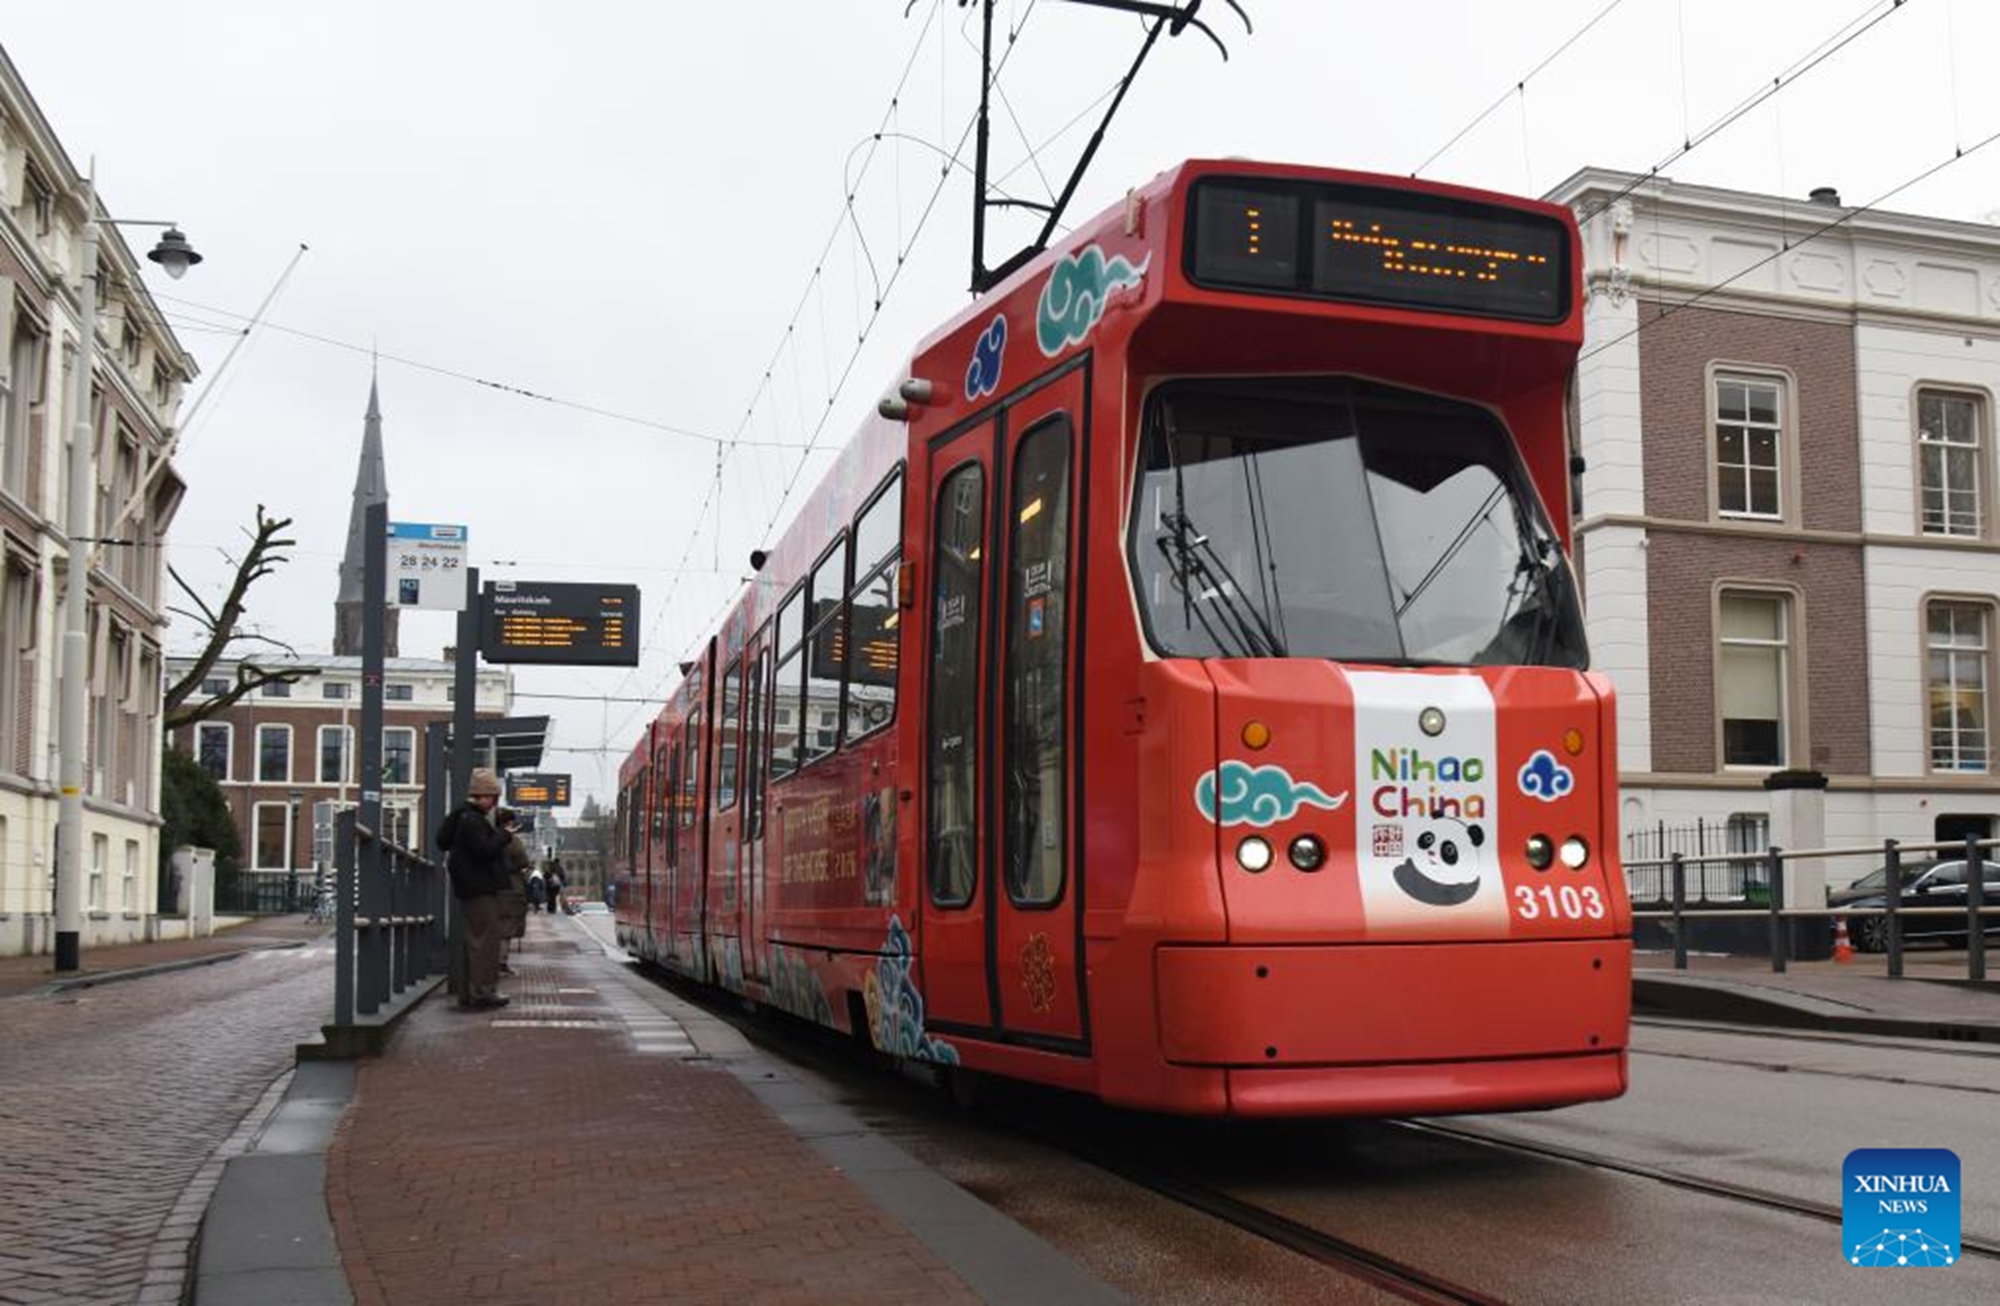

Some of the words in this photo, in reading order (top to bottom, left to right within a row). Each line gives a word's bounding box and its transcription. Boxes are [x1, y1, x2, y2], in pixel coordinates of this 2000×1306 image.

[401, 555, 417, 566] 28
[421, 556, 438, 567] 24
[442, 557, 459, 568] 22
[1371, 747, 1484, 782] Nihao
[1372, 785, 1485, 819] China
[1514, 884, 1605, 919] 3103
